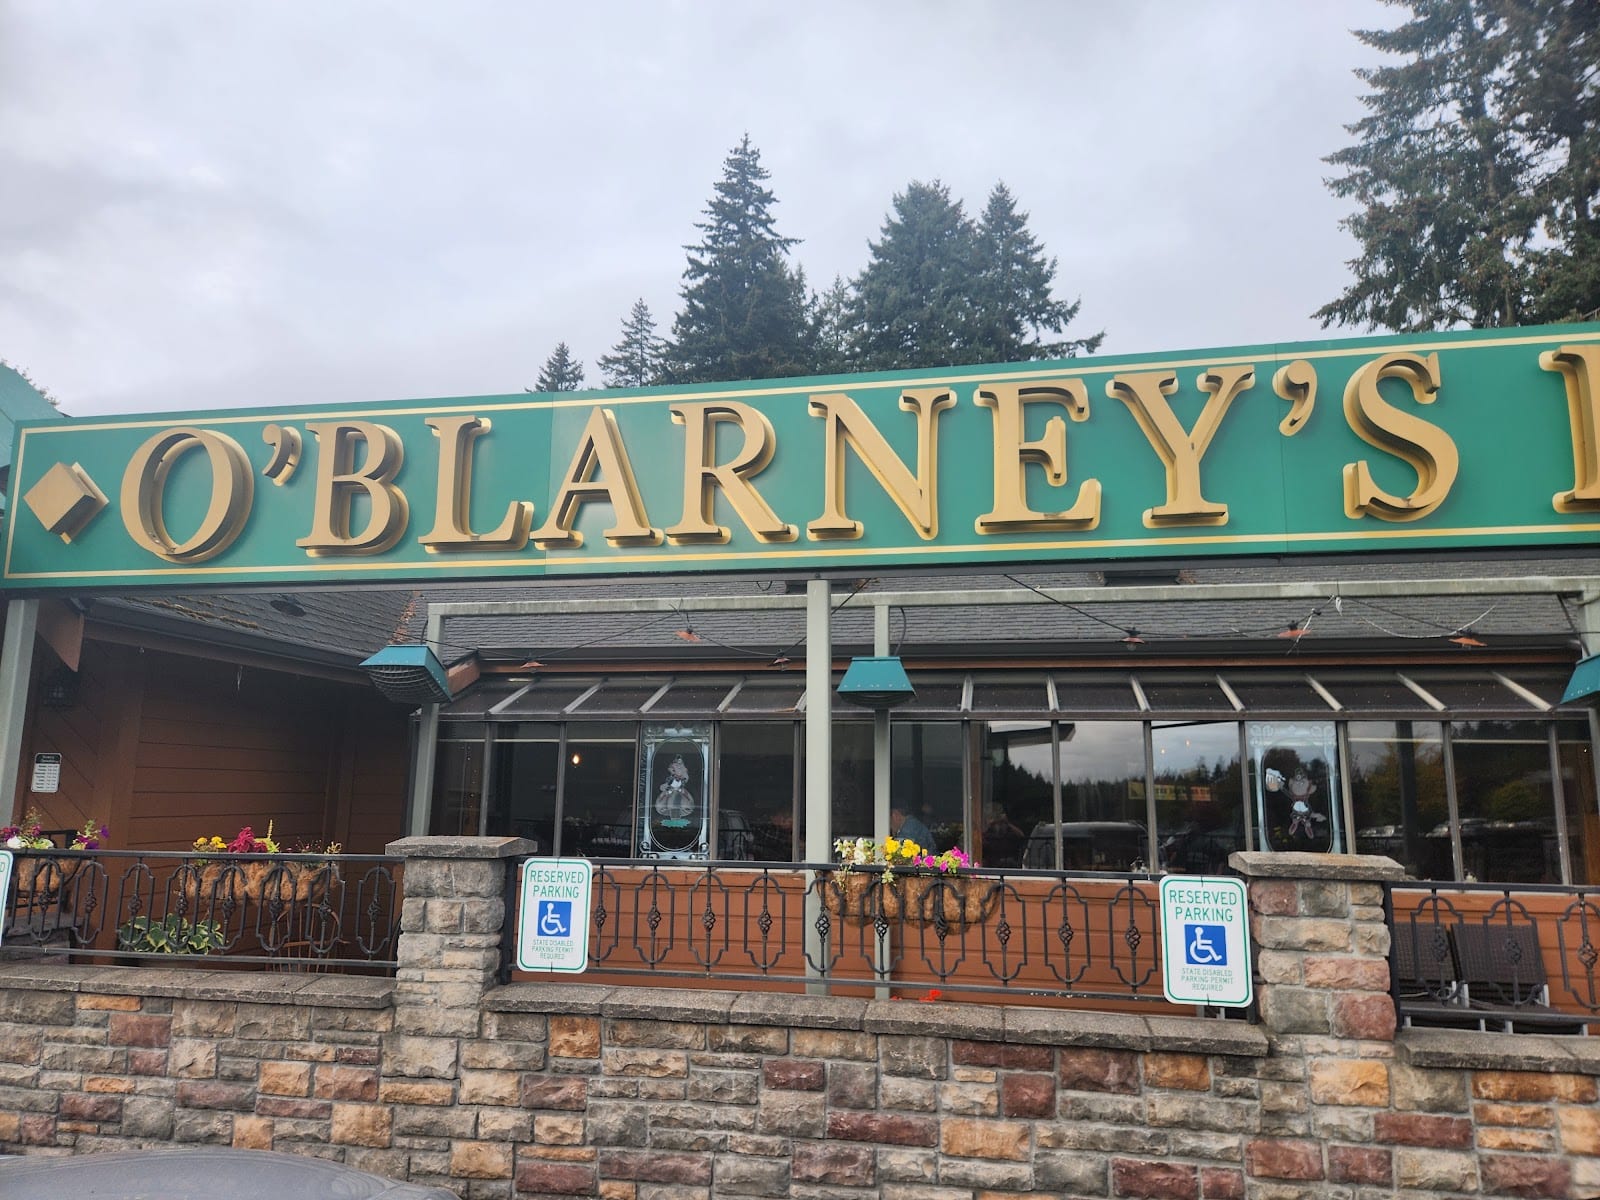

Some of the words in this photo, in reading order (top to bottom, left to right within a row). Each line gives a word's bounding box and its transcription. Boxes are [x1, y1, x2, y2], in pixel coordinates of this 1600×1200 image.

[120, 351, 1459, 565] O'BLARNEY'S
[529, 870, 584, 884] RESERVED
[533, 885, 579, 898] PARKING
[1169, 890, 1237, 905] RESERVED
[1175, 907, 1233, 922] PARKING
[531, 945, 553, 953] PARKING
[1181, 967, 1201, 976] STATE
[1202, 968, 1233, 977] DISABLED
[1180, 975, 1209, 983] PARKING
[1210, 976, 1234, 984] PERMIT
[1191, 983, 1224, 992] REQUIRED
